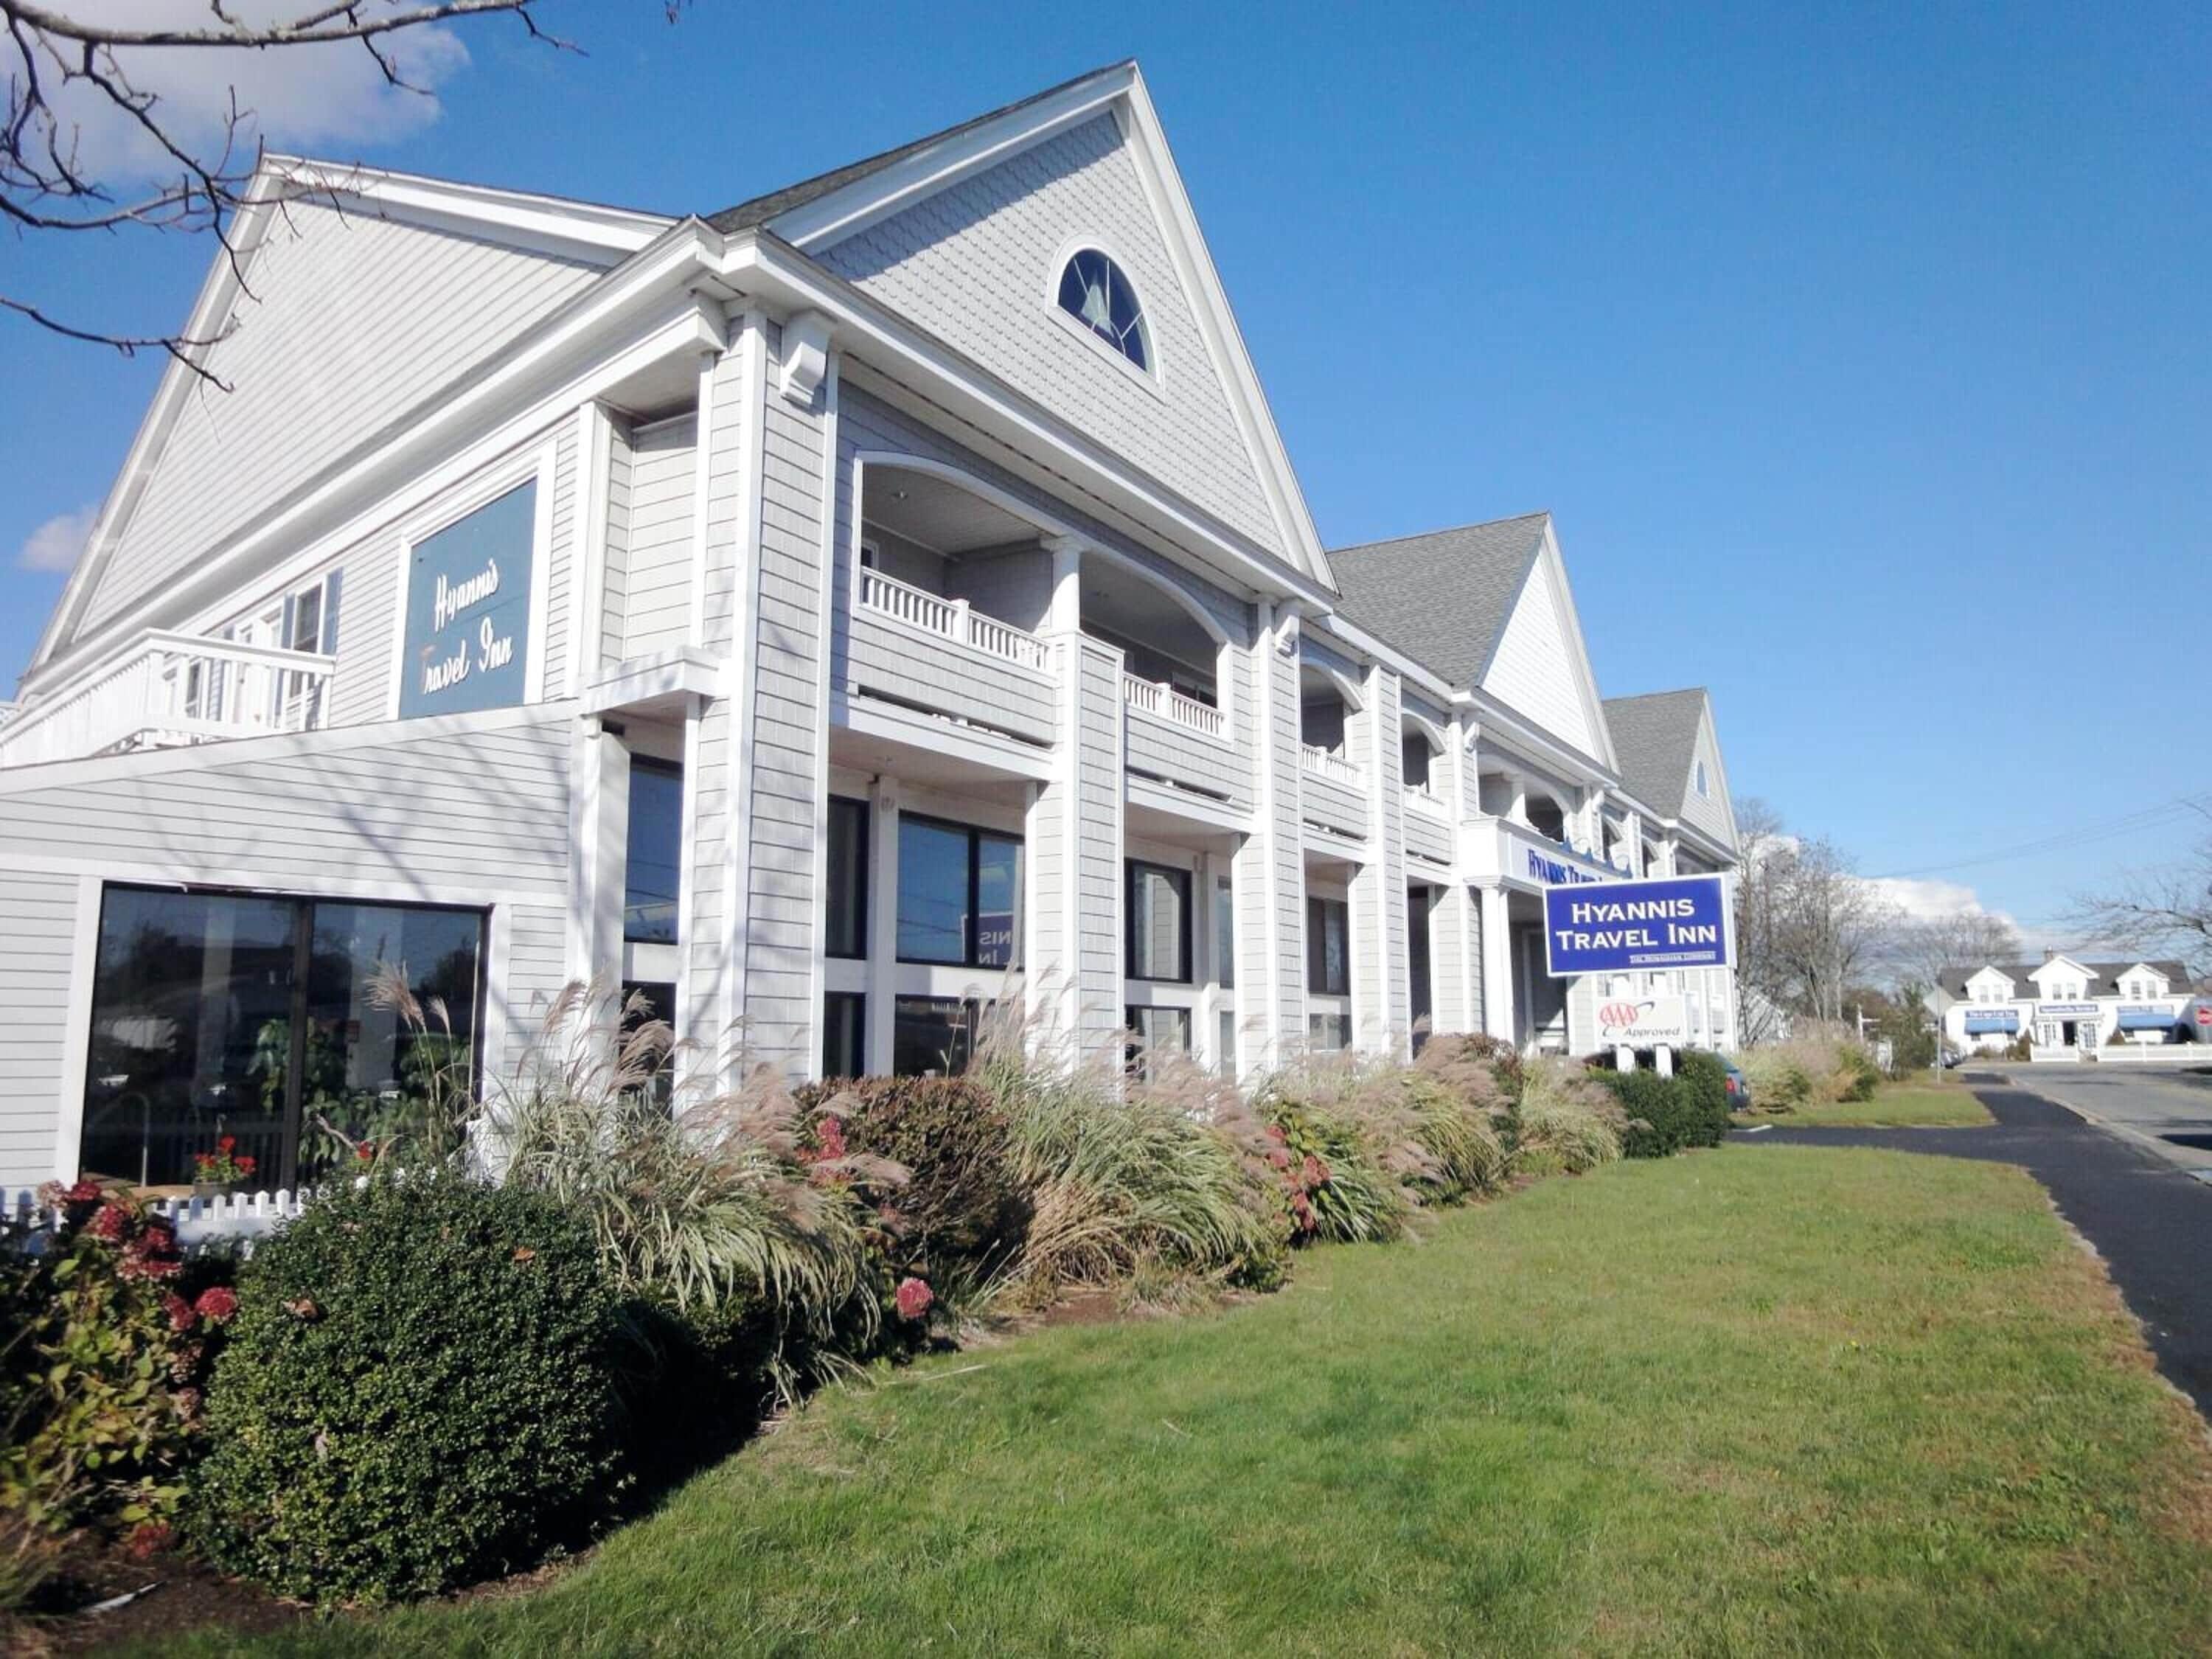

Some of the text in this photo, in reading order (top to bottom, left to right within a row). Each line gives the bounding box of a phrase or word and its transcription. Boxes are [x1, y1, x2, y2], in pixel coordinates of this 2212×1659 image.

[420, 616, 512, 695] ravel Inn
[1571, 898, 1695, 924] HYANNIS
[1555, 923, 1717, 951] TRAVEL INN
[1624, 1026, 1681, 1037] Approved
